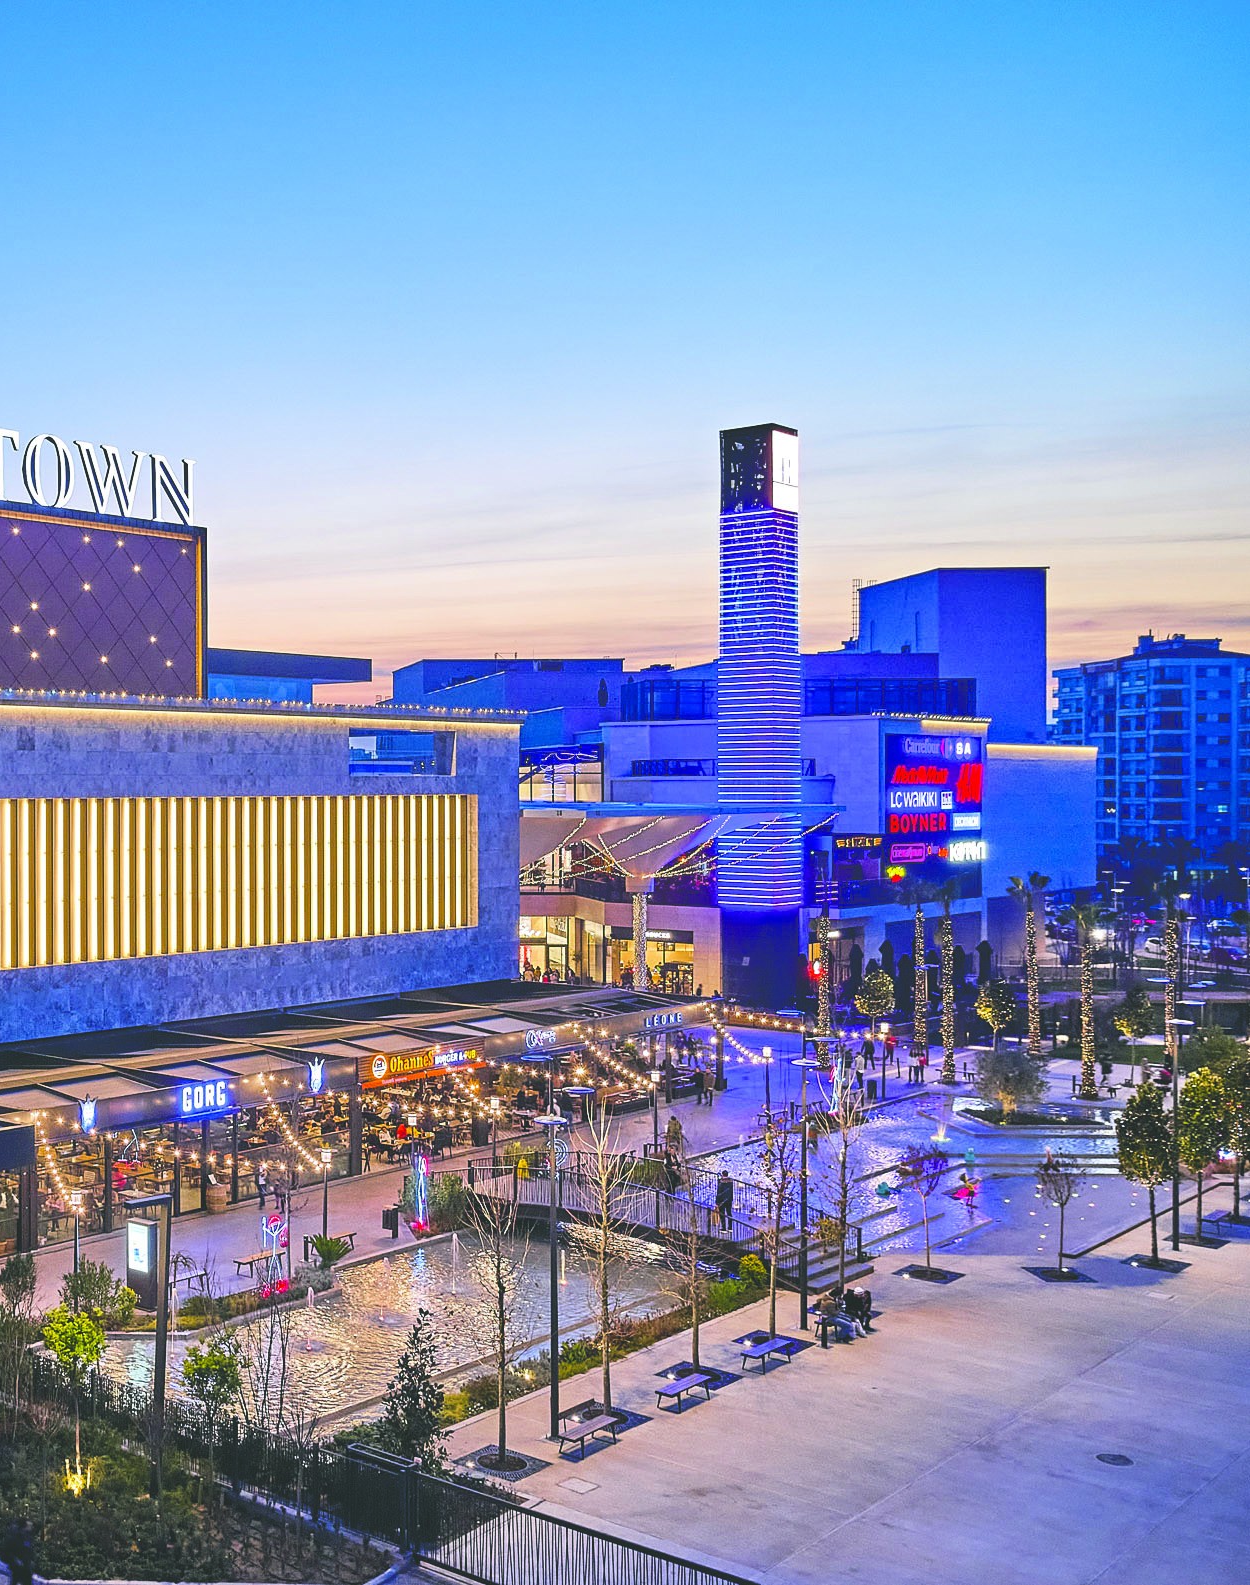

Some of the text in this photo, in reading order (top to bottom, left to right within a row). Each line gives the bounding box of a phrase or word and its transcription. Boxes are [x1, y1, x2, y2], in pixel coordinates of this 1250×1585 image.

[889, 812, 947, 834] BOYNER
[645, 1012, 682, 1028] LÉONE
[182, 1081, 226, 1113] GORG
